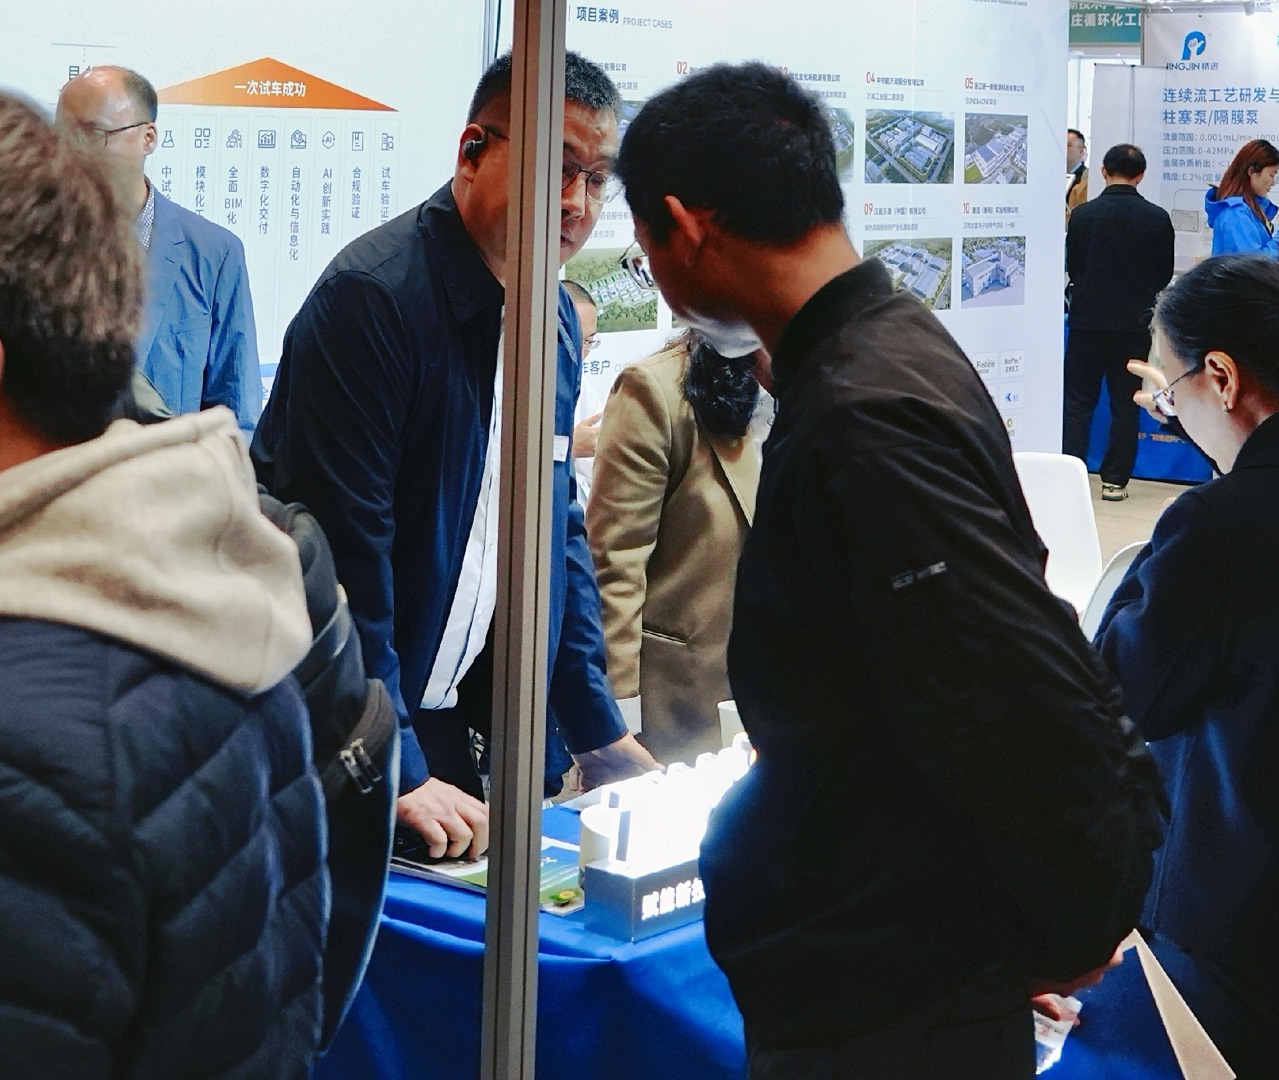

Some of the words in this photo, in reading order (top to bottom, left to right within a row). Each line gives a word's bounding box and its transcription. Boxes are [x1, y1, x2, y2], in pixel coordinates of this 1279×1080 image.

[576, 5, 619, 24] 项目案例
[623, 16, 651, 27] PROJECT
[652, 18, 673, 29] CASES
[676, 60, 688, 75] 02
[866, 71, 876, 84] 04
[965, 77, 974, 90] 05
[233, 78, 307, 98] 一次试车成功
[1162, 108, 1259, 126] 柱塞泵/隔膜泵
[258, 165, 270, 235] 数字化交付
[351, 166, 362, 219] 合规验证
[288, 165, 301, 261] 自动化与信息化
[864, 202, 874, 215] 09
